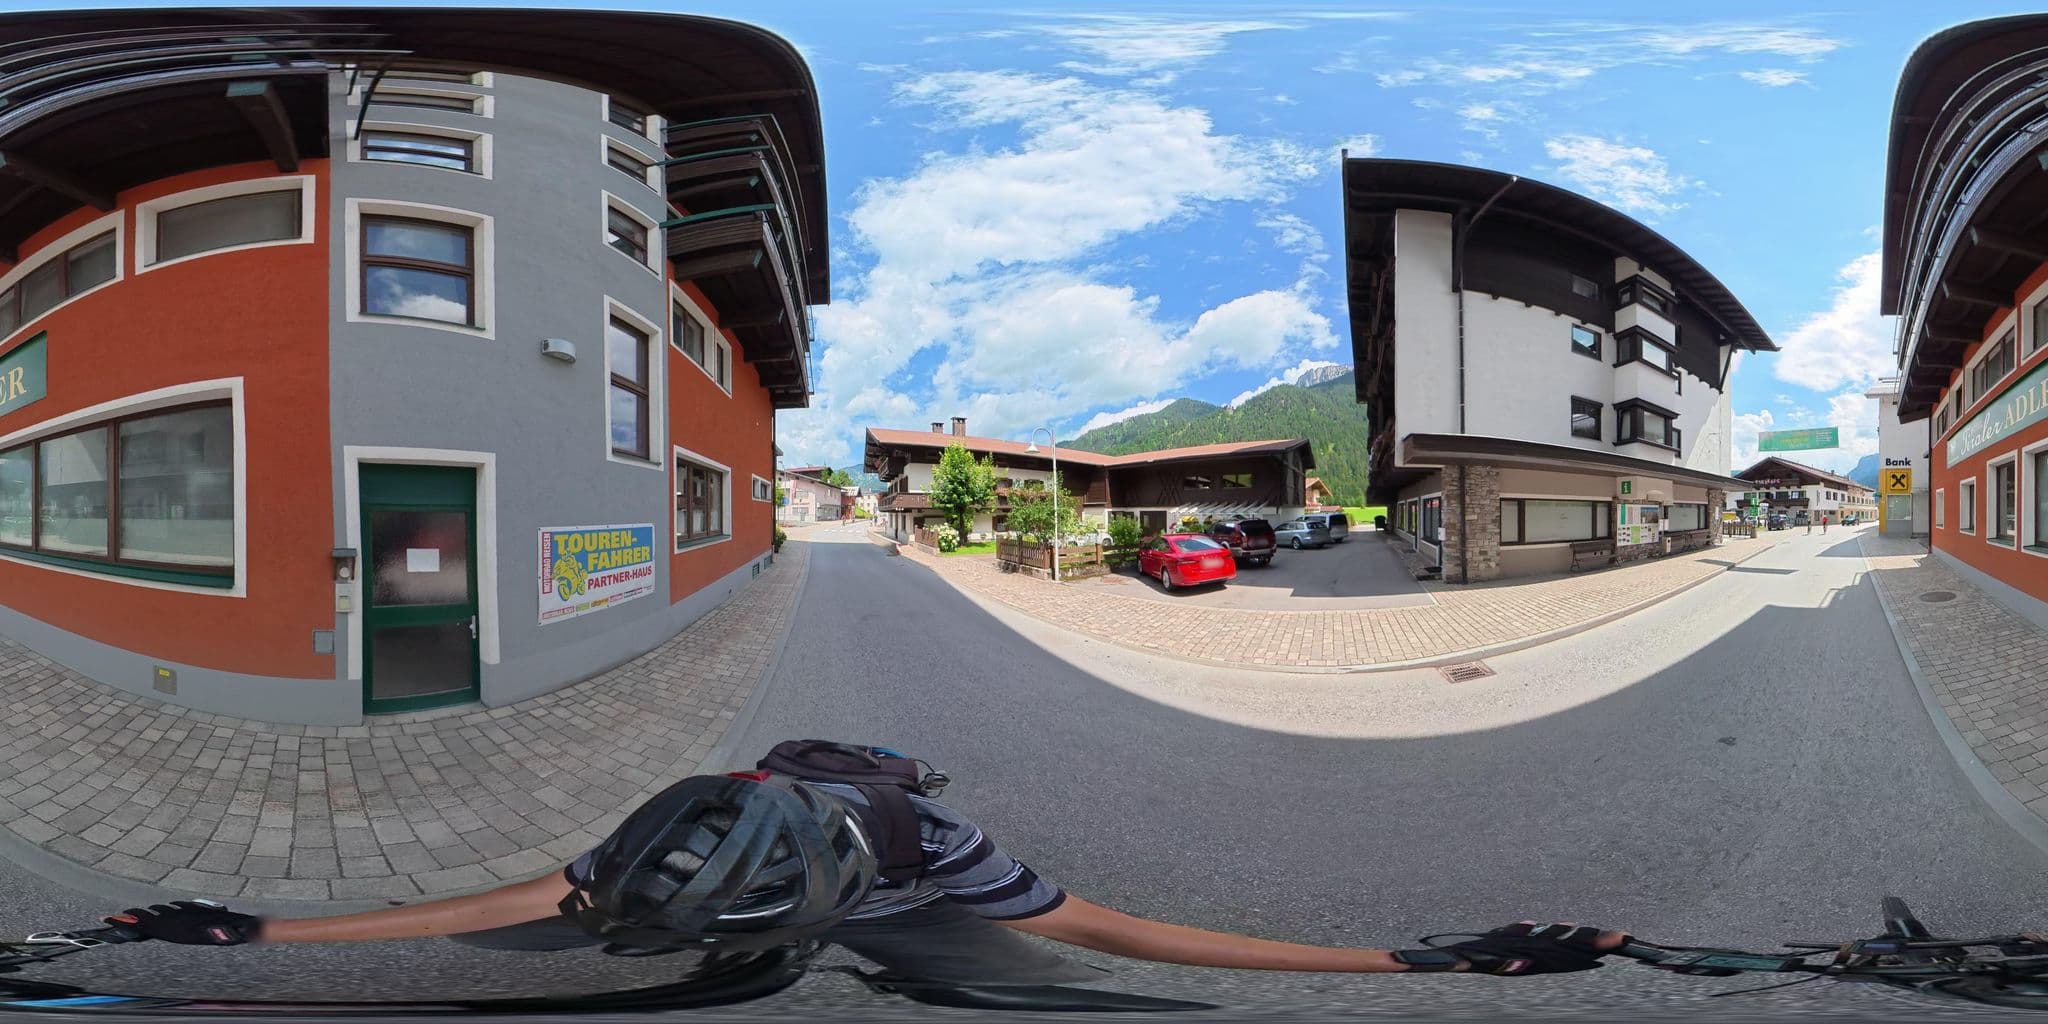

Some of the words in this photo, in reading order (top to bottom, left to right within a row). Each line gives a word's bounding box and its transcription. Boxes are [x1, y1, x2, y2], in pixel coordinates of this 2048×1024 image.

[1885, 457, 1912, 466] Bank
[554, 530, 637, 555] TOUREN-
[587, 545, 651, 572] FAHRER
[588, 565, 653, 590] PARTNER-HAUS
